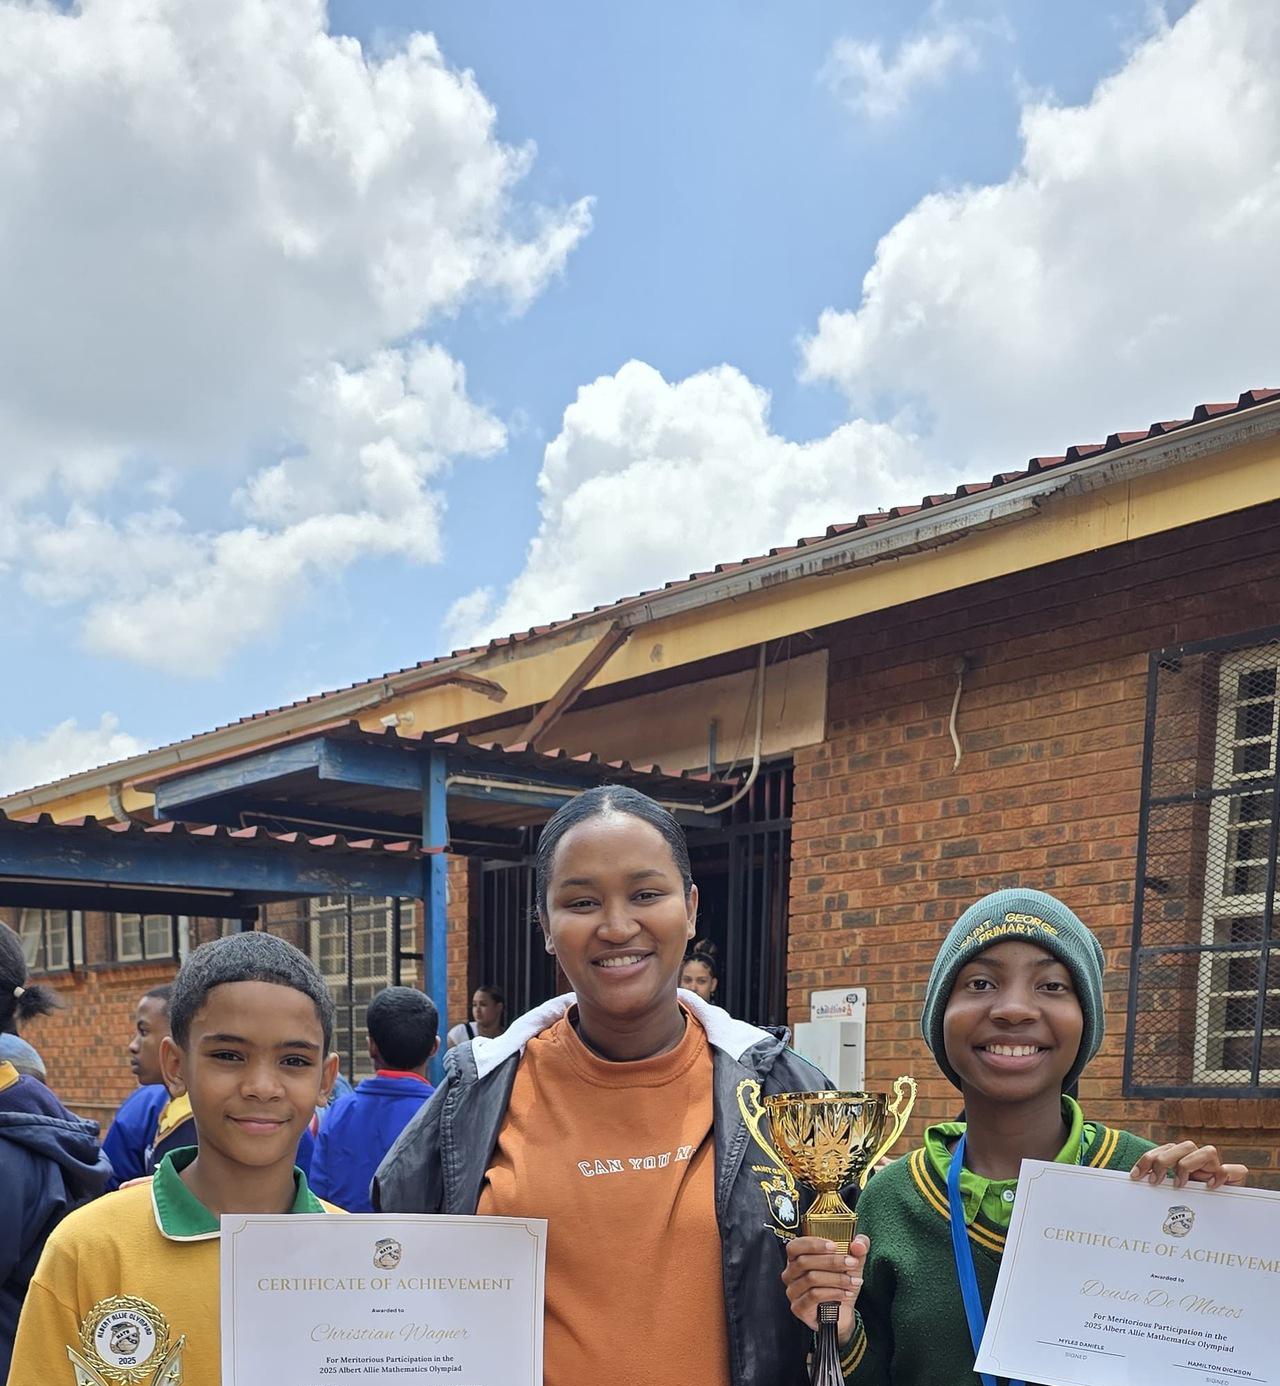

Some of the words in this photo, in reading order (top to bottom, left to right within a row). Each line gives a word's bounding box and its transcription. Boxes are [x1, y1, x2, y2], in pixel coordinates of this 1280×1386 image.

[960, 919, 994, 948] SAINT
[1005, 912, 1058, 936] GEORGE
[978, 923, 1035, 944] PRIMARY
[578, 1160, 624, 1177] CAN
[629, 1152, 671, 1170] YOU
[1043, 1227, 1151, 1254] CERTIFICATE
[1155, 1243, 1177, 1257] OF
[257, 1278, 365, 1291] CERTIFICATE
[370, 1278, 391, 1290] OF
[399, 1278, 514, 1291] ACHIEVEMENT
[1150, 1273, 1177, 1282] Awarded
[1079, 1279, 1140, 1303] Deusa
[1143, 1289, 1176, 1309] De
[1178, 1294, 1243, 1319] Matos
[97, 1318, 112, 1338] ALBERT
[112, 1312, 127, 1321] ALLIE
[129, 1313, 153, 1336] OLYMPIAD
[310, 1324, 394, 1342] Christian
[399, 1323, 470, 1344] Wagner
[1093, 1312, 1106, 1321] For
[1108, 1315, 1152, 1329] Meritorious
[1153, 1322, 1203, 1337] Participation
[1204, 1330, 1213, 1339] in
[1214, 1332, 1228, 1341] the
[1058, 1338, 1079, 1347] MYLES
[1079, 1342, 1105, 1351] DANIELS
[1083, 1321, 1102, 1331] 2025
[1102, 1324, 1126, 1335] Albert
[1127, 1327, 1145, 1338] Allie
[1146, 1331, 1196, 1346] Mathematics
[1197, 1338, 1234, 1353] Olympiad
[118, 1357, 136, 1365] 2025
[326, 1356, 339, 1364] For
[340, 1356, 384, 1364] Meritorious
[386, 1356, 432, 1365] Participation
[433, 1355, 441, 1363] in
[1065, 1352, 1088, 1361] SIGNED
[338, 1366, 362, 1374] Albert
[363, 1365, 380, 1373] Allie
[381, 1365, 428, 1373] Mathematics
[429, 1364, 462, 1373] Olympiad
[1187, 1361, 1221, 1372] HAMILTON
[1222, 1366, 1252, 1376] DICKSON
[1205, 1377, 1229, 1386] SIGNED
